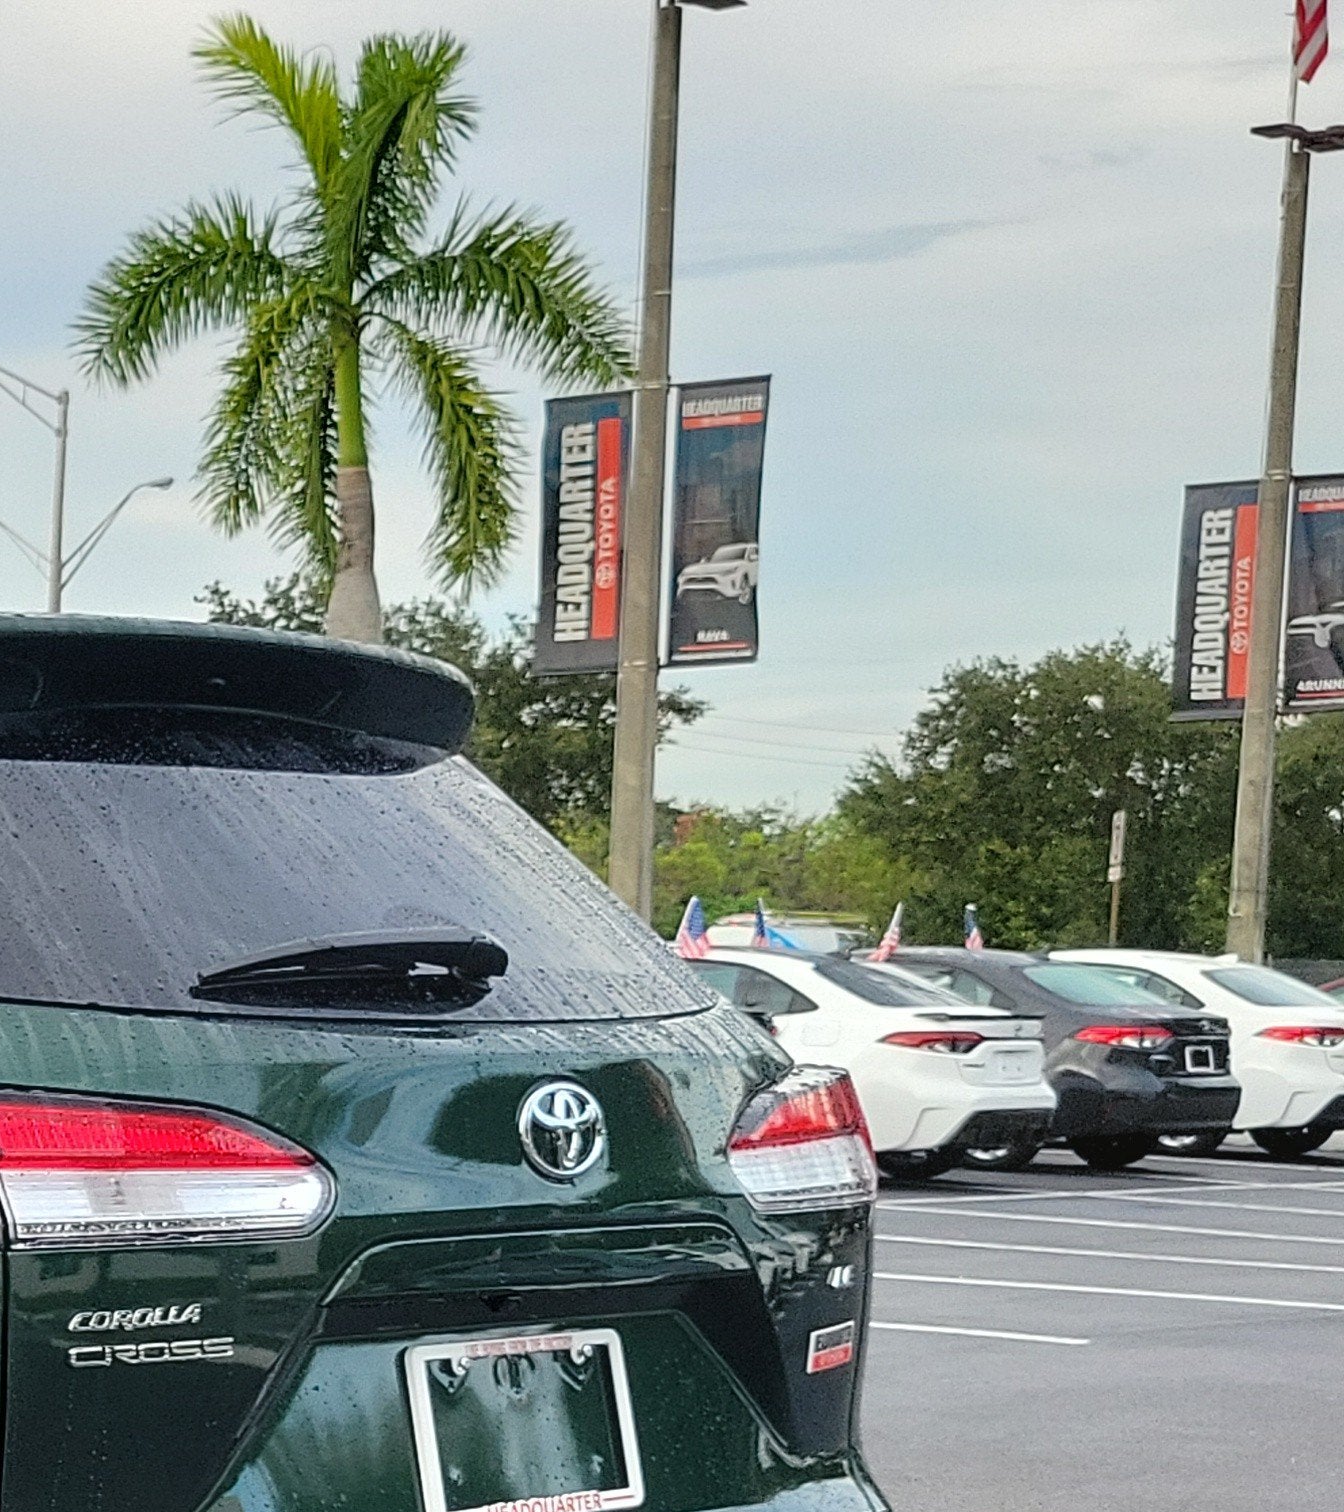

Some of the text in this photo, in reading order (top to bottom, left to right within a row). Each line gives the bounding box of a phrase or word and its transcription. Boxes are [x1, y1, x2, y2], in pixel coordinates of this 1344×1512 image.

[554, 421, 595, 642] HEADQUARTER
[598, 477, 617, 561] TOYOTA
[1191, 507, 1234, 700] HEADQUARTER
[1232, 555, 1252, 631] TOYOTA
[68, 1303, 201, 1331] COROLLA
[68, 1337, 235, 1367] CROSS
